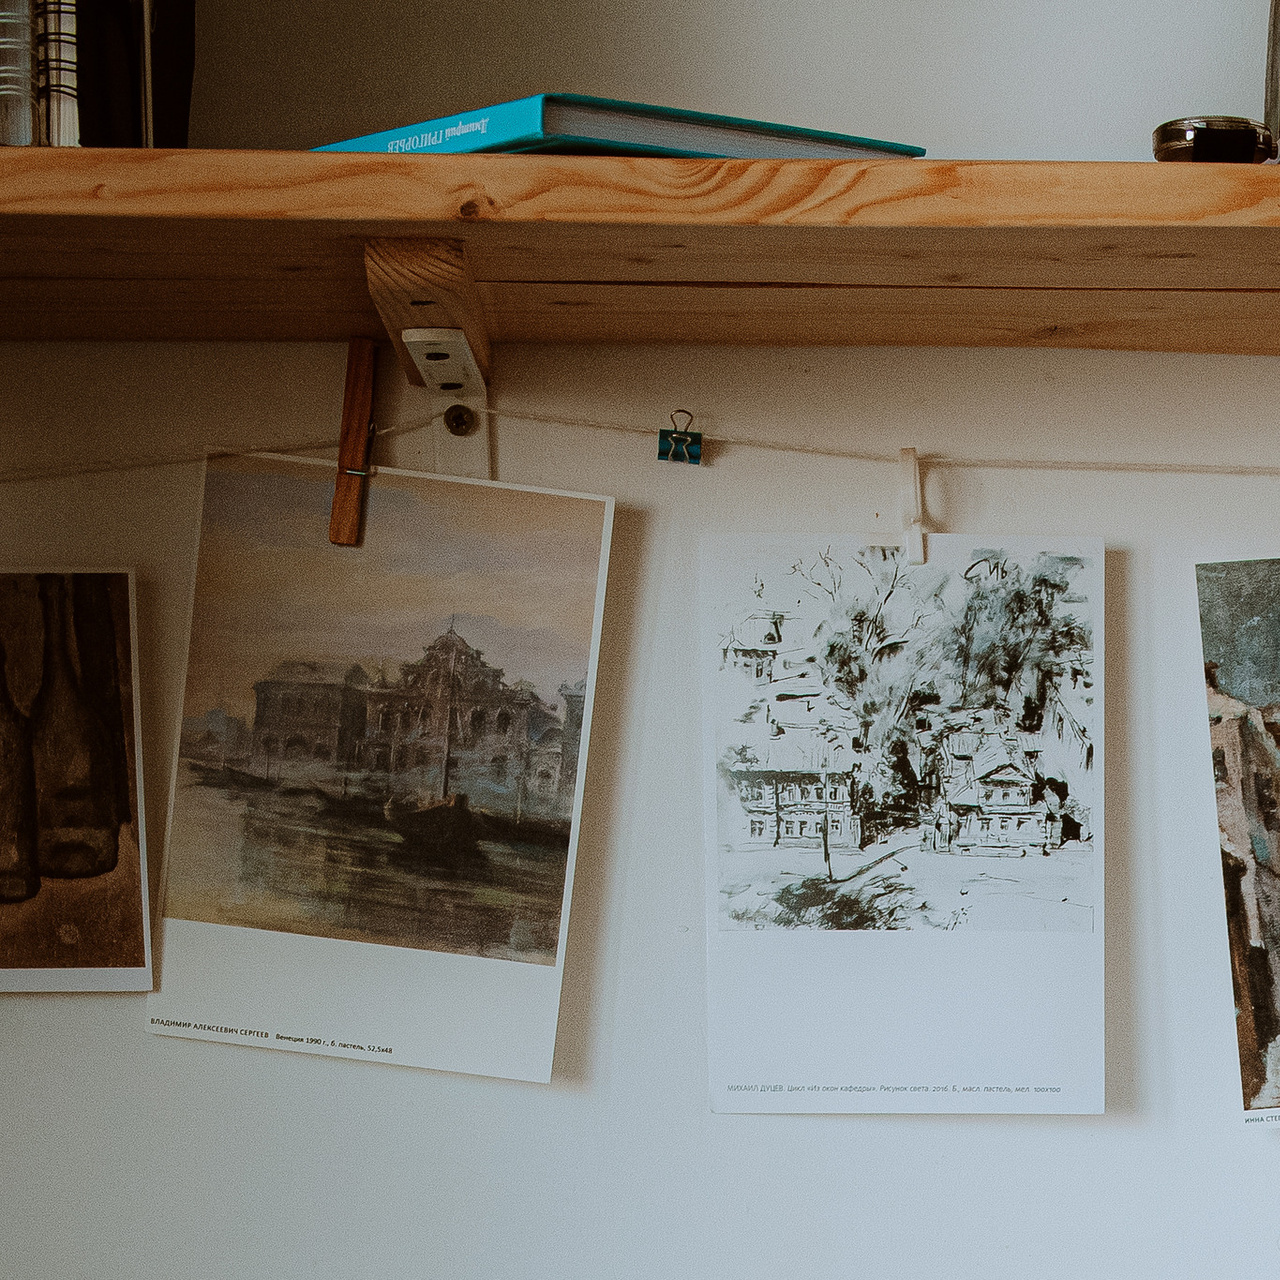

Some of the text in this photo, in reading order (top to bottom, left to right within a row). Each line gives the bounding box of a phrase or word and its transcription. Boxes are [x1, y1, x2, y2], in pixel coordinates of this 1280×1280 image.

[387, 117, 490, 154] Дмитрий ГРИГОРЬЕВ
[150, 1017, 192, 1029] ВЛАДИМИР
[193, 1022, 239, 1035] АЛЕКСЕЕВИЧ
[240, 1028, 270, 1039] СЕРГЕЕВ
[727, 1084, 759, 1092] МИХАИЛ
[879, 1085, 908, 1094] Рисунок
[1244, 1115, 1265, 1124] ИННА
